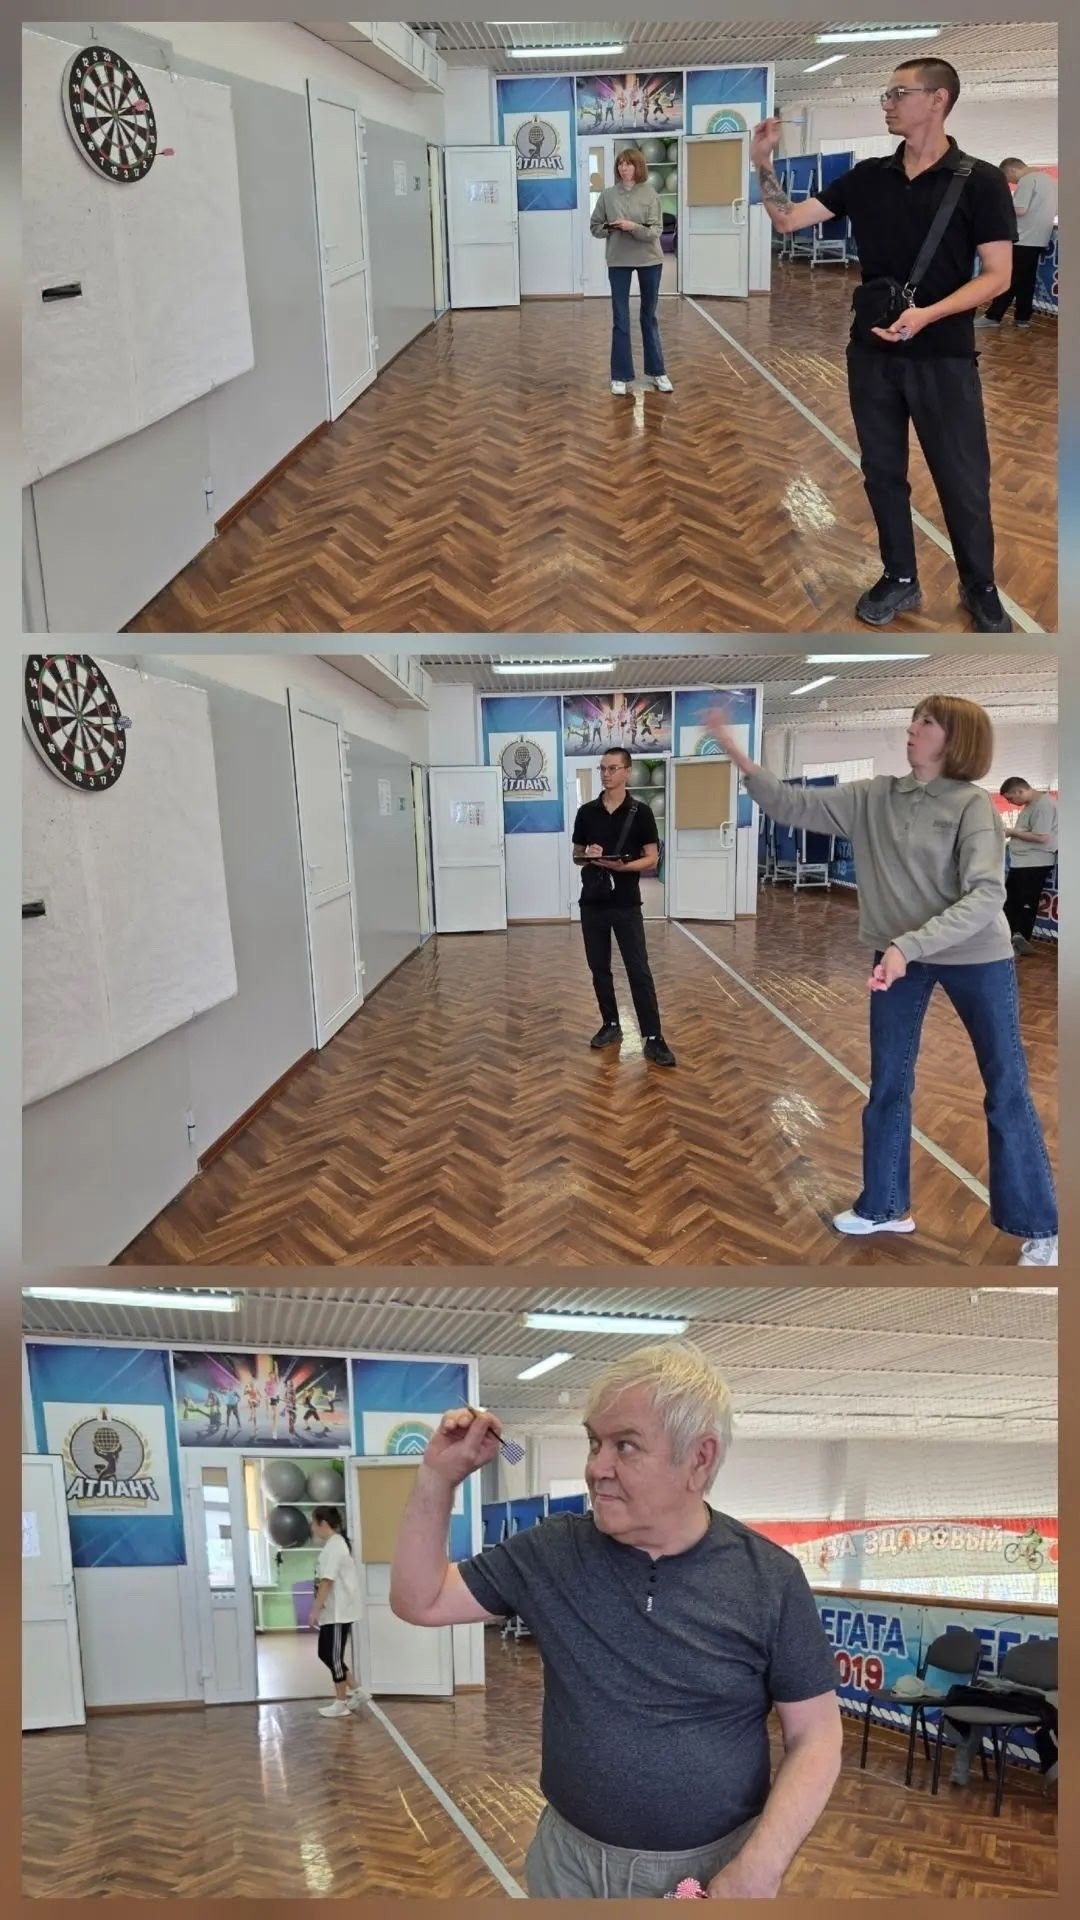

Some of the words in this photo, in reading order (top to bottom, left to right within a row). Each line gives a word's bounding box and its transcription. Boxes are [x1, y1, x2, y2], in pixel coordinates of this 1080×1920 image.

[66, 1475, 160, 1501] АТЛАНТ
[818, 1606, 908, 1659] ЕГАТА
[835, 1649, 884, 1691] 019
